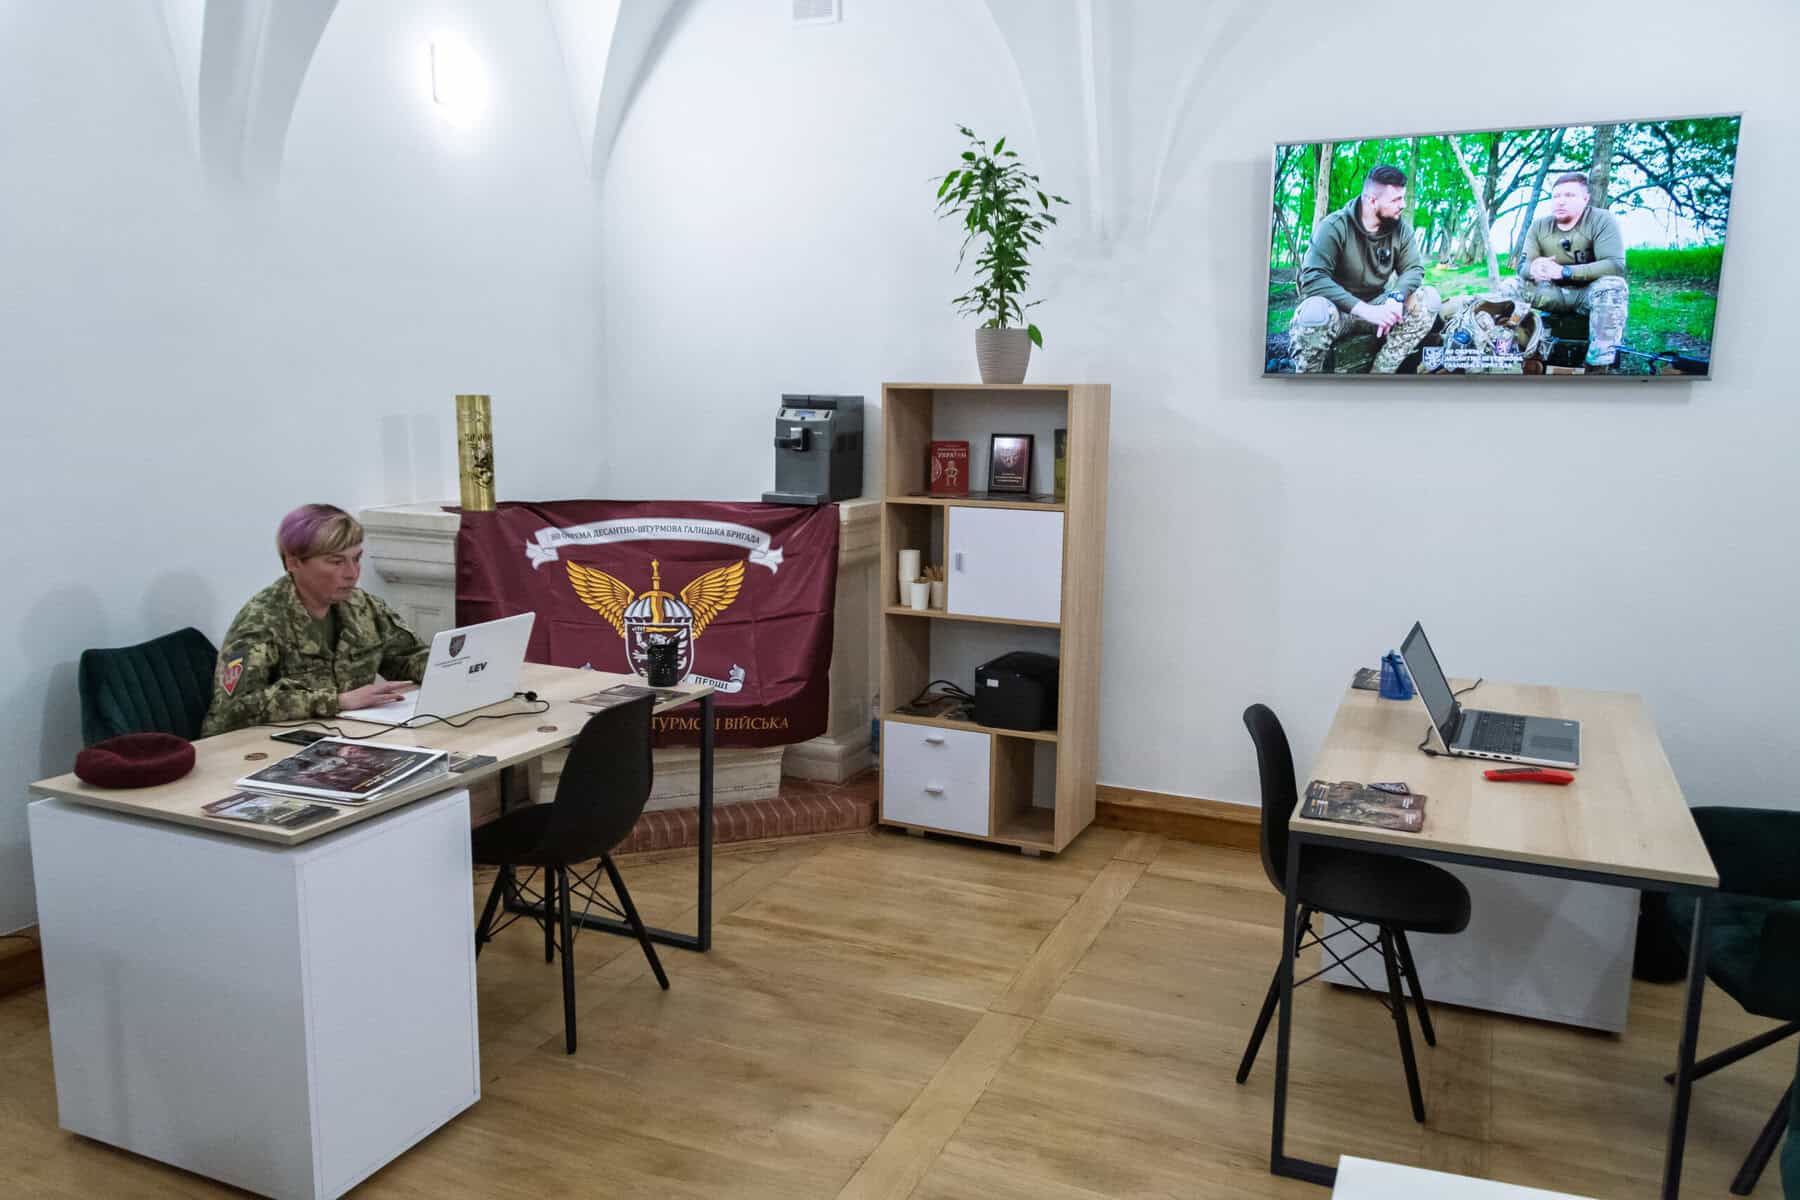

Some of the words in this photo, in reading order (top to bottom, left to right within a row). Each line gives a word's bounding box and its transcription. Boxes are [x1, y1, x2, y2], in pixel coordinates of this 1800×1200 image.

[593, 524, 682, 537] ДЕСАНТНО-ШТУРМОВА
[683, 525, 725, 537] ГАЛИЦЬКА
[726, 530, 760, 544] БРИГАДА
[468, 661, 488, 674] LEV
[694, 676, 729, 690] ПЕРШІ
[725, 715, 790, 731] ВІЙСЬКА
